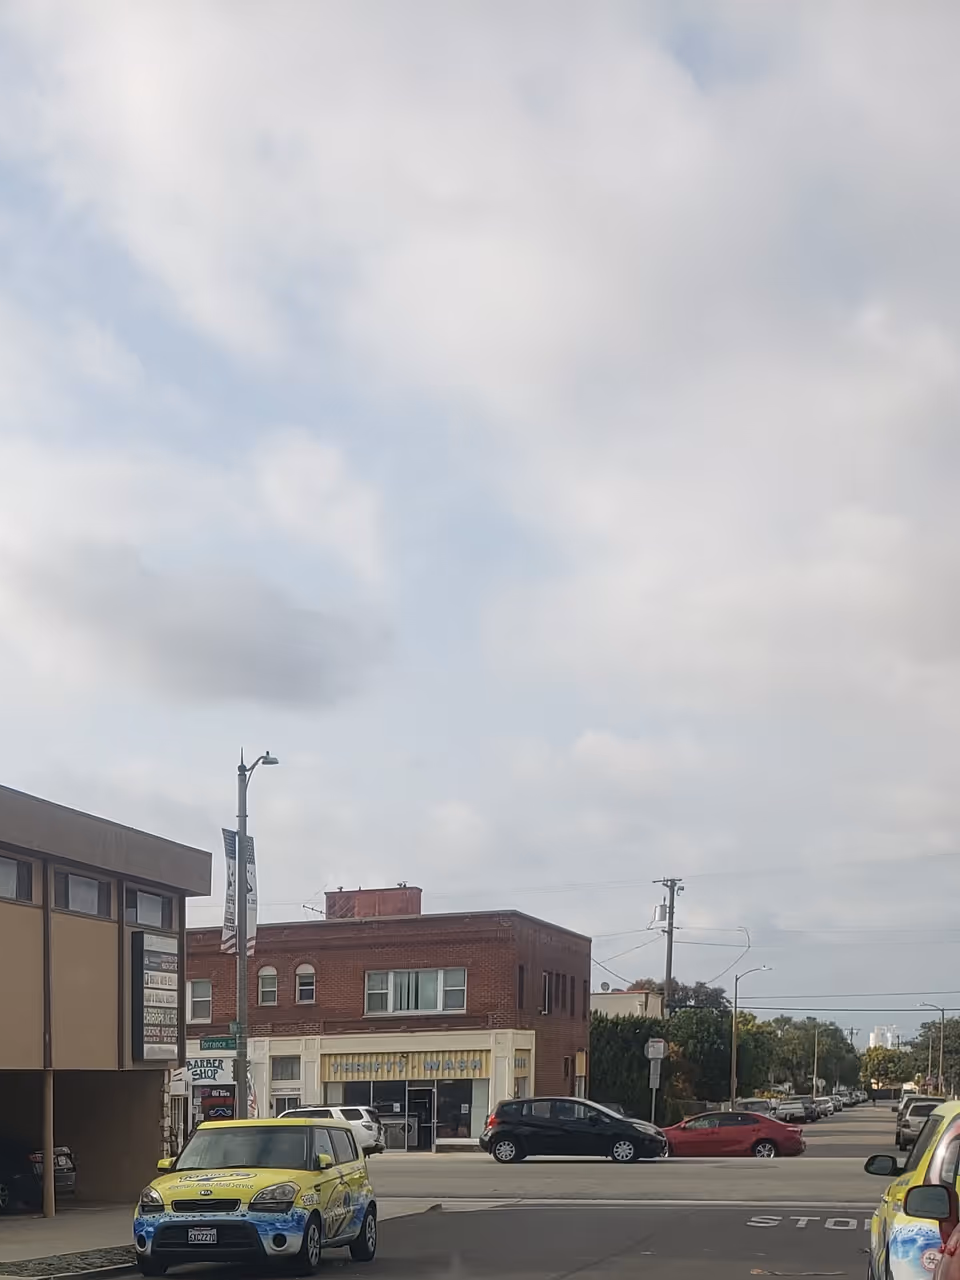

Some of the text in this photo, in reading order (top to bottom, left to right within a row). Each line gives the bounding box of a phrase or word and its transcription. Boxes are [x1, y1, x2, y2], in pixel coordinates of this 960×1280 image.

[201, 1041, 226, 1049] Torrance
[186, 1059, 224, 1072] BARBER
[331, 1058, 483, 1074] THRIFTY WASH
[192, 1068, 218, 1082] SHOP
[231, 1182, 254, 1190] Service
[746, 1216, 871, 1231] STO
